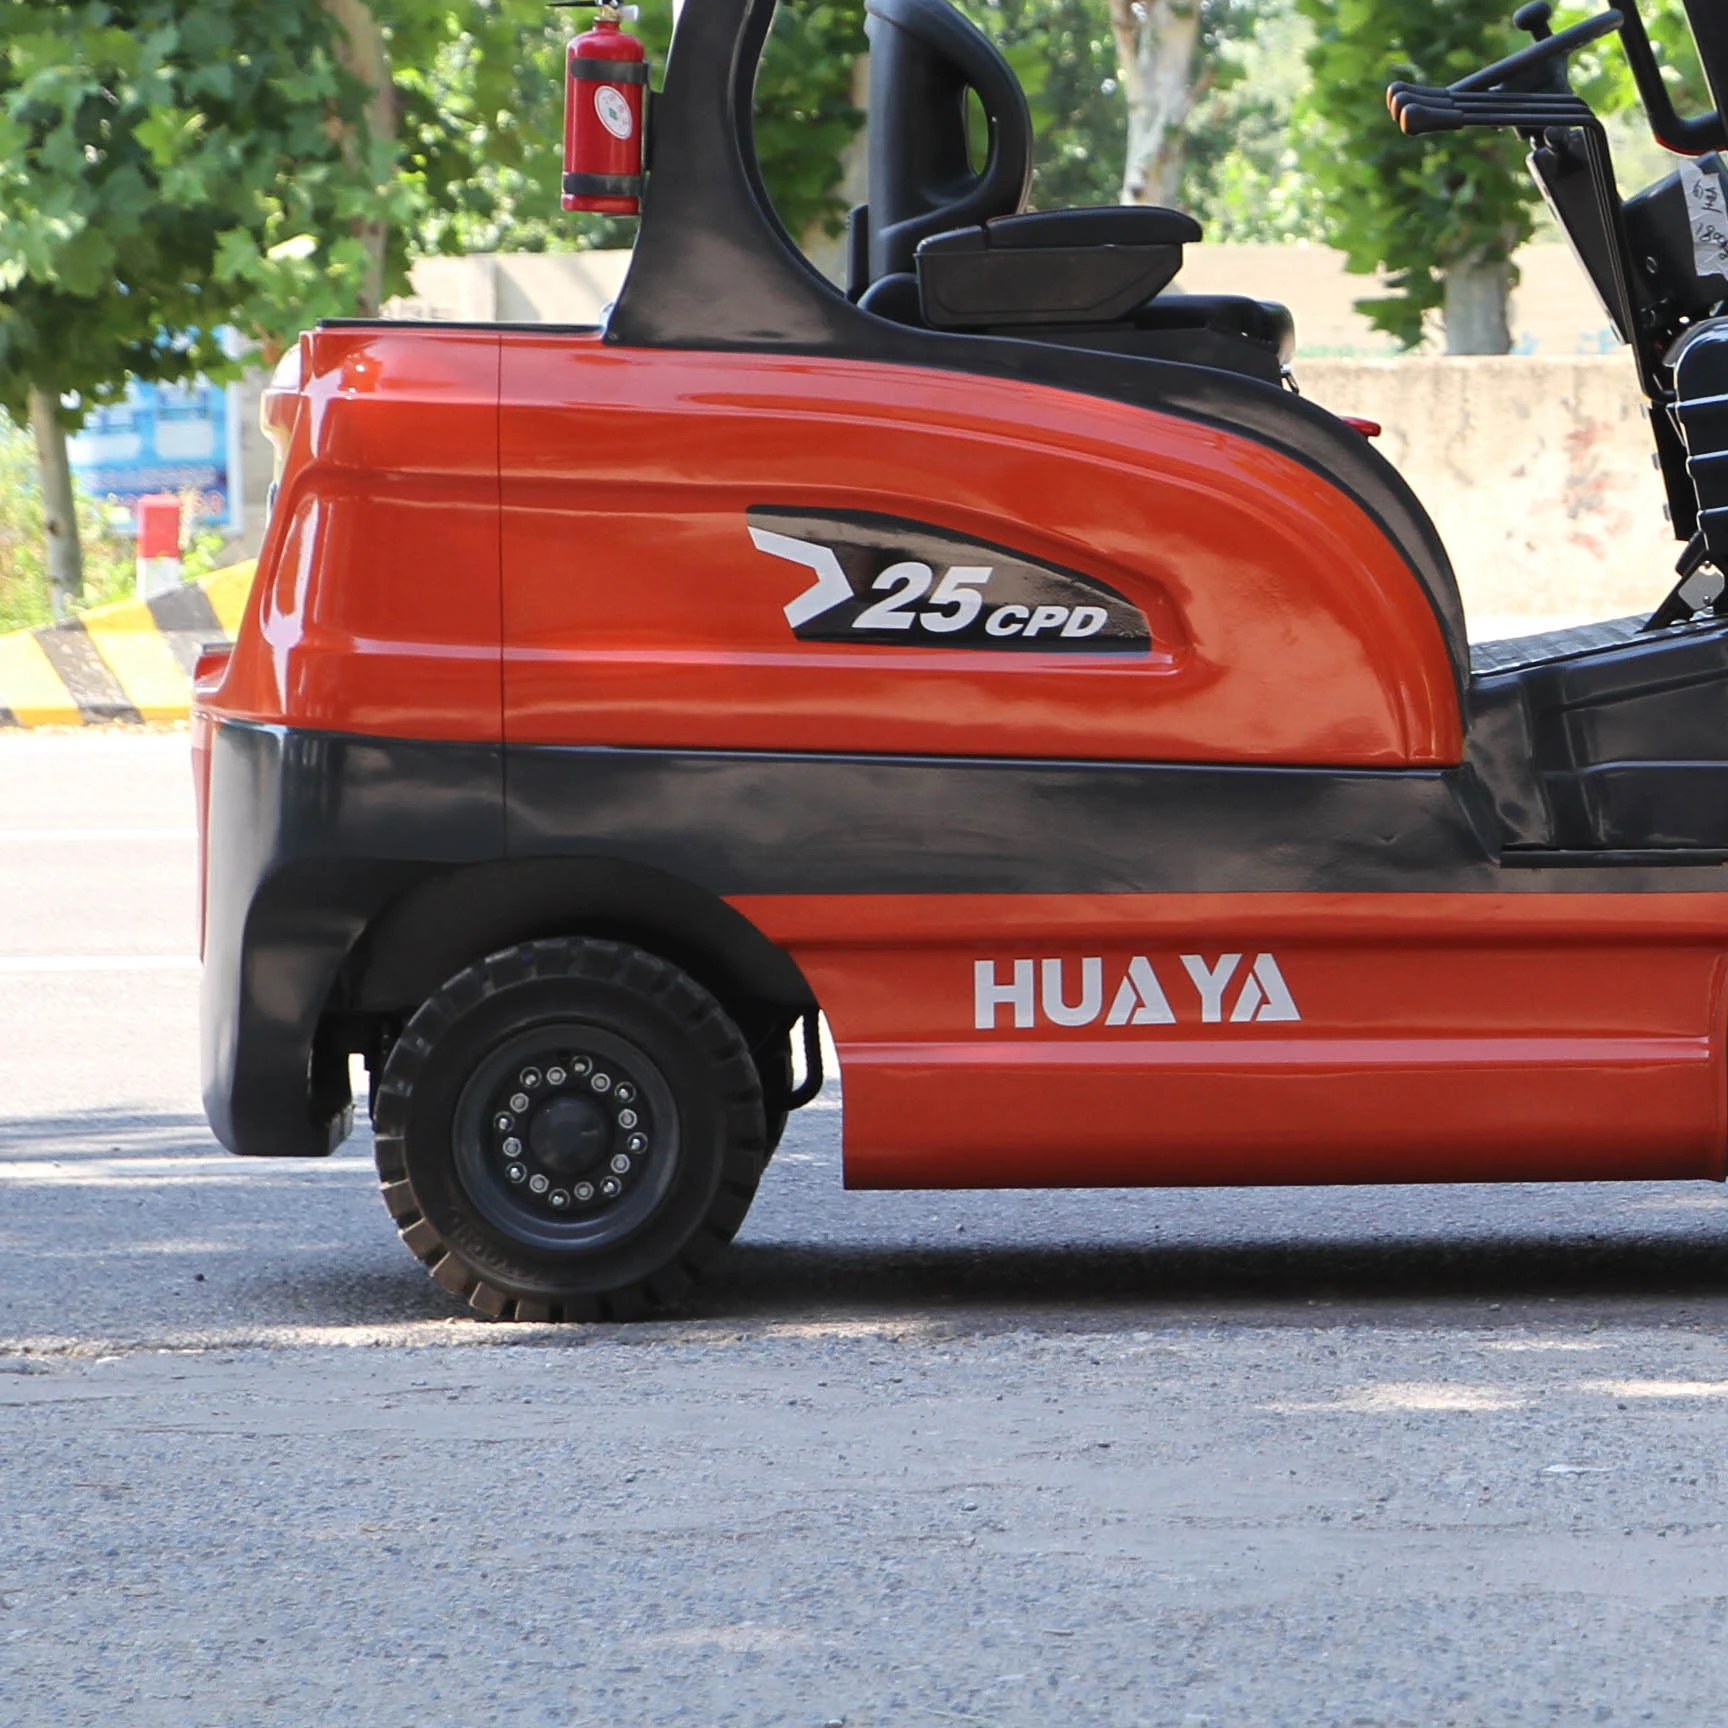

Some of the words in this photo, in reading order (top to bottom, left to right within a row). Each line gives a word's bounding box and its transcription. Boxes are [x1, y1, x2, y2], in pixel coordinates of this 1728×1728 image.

[851, 561, 993, 633] 25
[984, 604, 1108, 638] CPD
[973, 952, 1302, 1030] HUAYA
